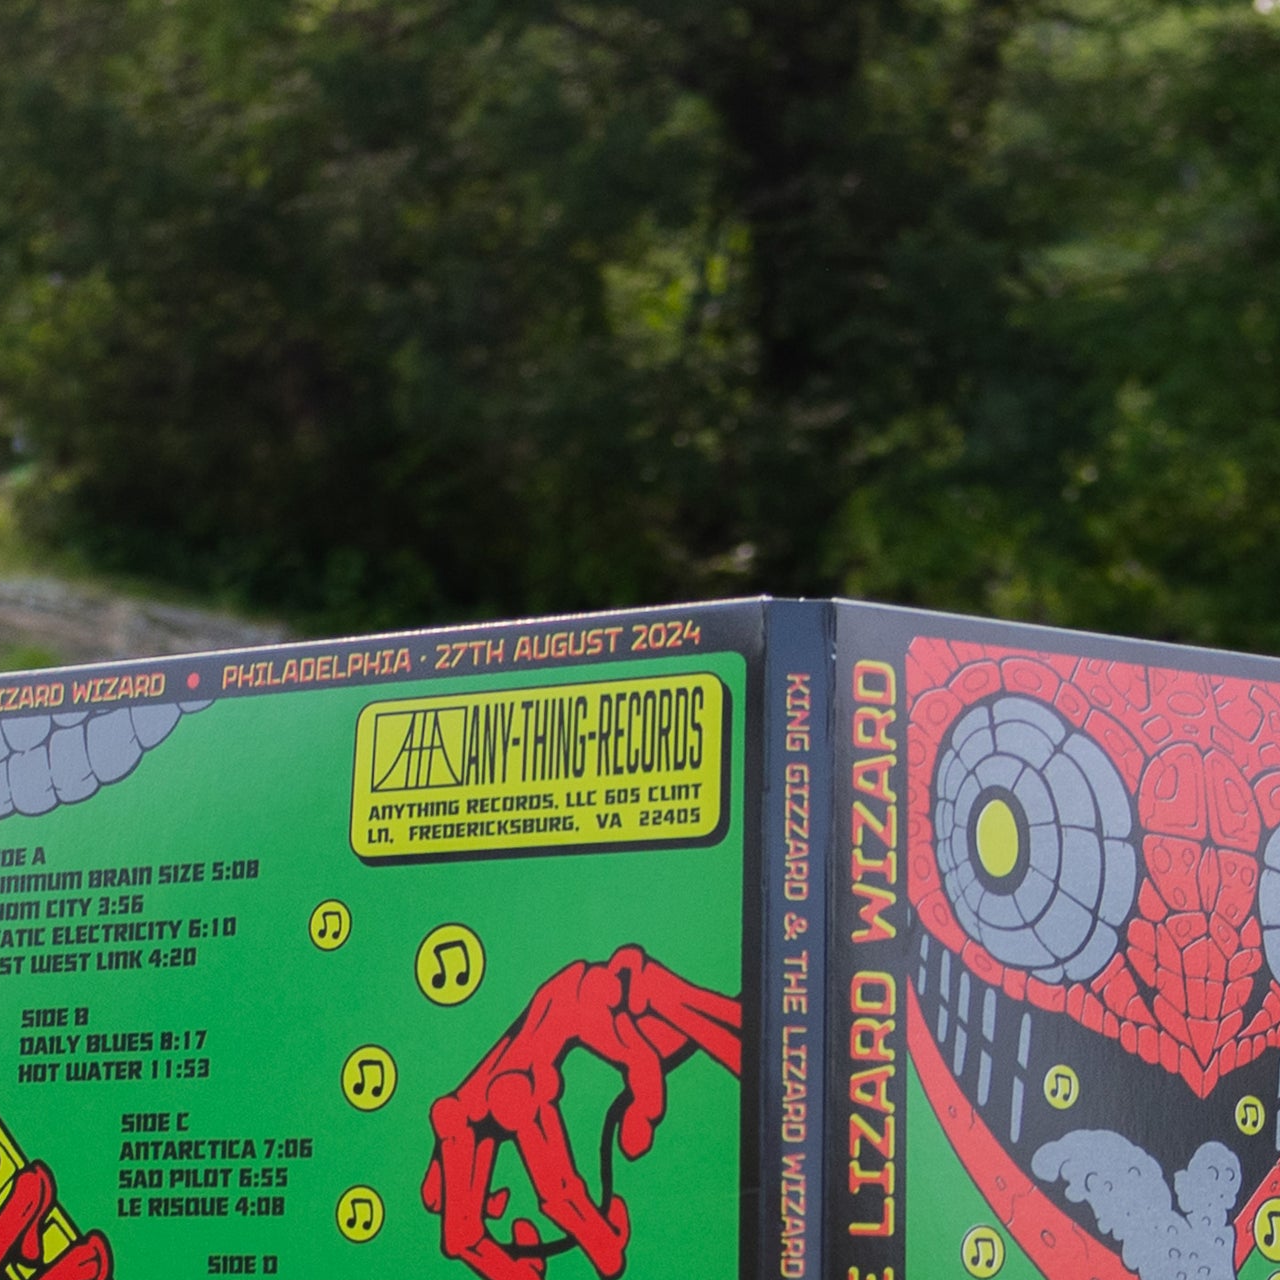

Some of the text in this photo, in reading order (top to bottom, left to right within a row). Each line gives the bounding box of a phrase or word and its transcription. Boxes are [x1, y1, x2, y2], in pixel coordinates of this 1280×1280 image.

[72, 672, 166, 702] WIZARD
[222, 647, 412, 689] PHILADELPHIA
[434, 638, 504, 671] 27TH
[514, 628, 623, 662] AUGUST
[631, 620, 700, 651] 2024
[785, 673, 811, 753] KING
[468, 686, 702, 786] ANY-THING-RECORDS
[368, 800, 460, 821] ANYTHING
[566, 790, 597, 809] LLC
[605, 787, 641, 805] 605
[648, 782, 702, 803] CLINT
[851, 658, 898, 943] WIZARD
[595, 812, 623, 830] VA
[639, 806, 701, 827] 22405
[784, 764, 811, 903] GIZZARD
[32, 847, 46, 865] A
[89, 866, 152, 888] BRAIN
[158, 863, 205, 884] SIZE
[212, 859, 259, 881] 5:08
[47, 897, 93, 919] CITY
[99, 895, 144, 916] 3:56
[52, 920, 182, 945] ELECTRICITY
[188, 917, 236, 938] 6:10
[783, 913, 809, 943] &
[31, 953, 91, 974] WEST
[97, 950, 142, 970] LINK
[148, 947, 196, 967] 4:20
[782, 951, 808, 1015] THE
[21, 1007, 89, 1028] SIDE B
[20, 1030, 207, 1056] DAILY BLUES 8:17
[19, 1059, 209, 1083] HOT WATER 11:53
[781, 1026, 807, 1145] LIZARD
[849, 970, 897, 1238] LIZARD
[121, 1112, 190, 1132] SIDE C
[119, 1138, 313, 1161] ANTARCTICA 7:06
[118, 1167, 288, 1189] SAD PILOT 6:55
[118, 1197, 141, 1217] LE
[235, 1197, 285, 1216] 4:08
[780, 1154, 806, 1280] WIZARD
[208, 1255, 277, 1275] SIDE D
